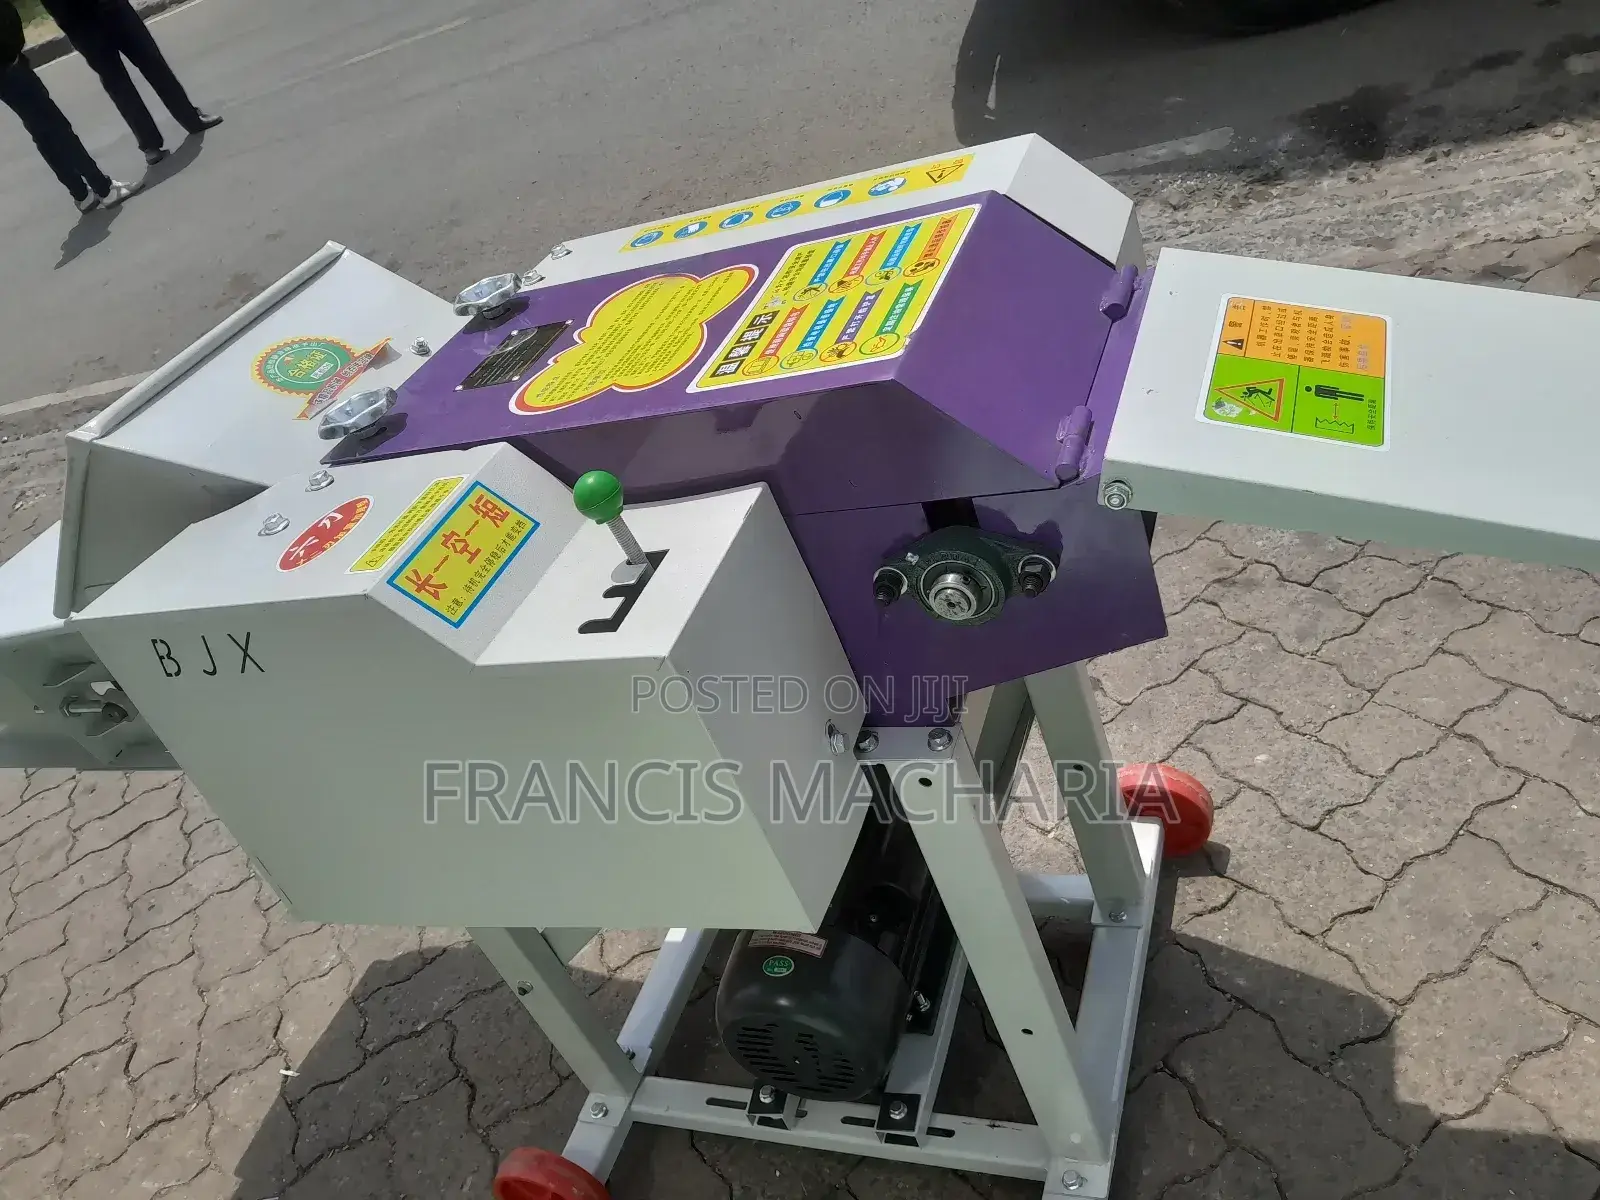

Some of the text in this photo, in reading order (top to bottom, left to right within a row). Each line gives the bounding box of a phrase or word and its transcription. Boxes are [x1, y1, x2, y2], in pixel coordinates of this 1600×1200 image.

[404, 567, 449, 602] 长
[440, 531, 482, 565] 空
[468, 493, 511, 529] 短
